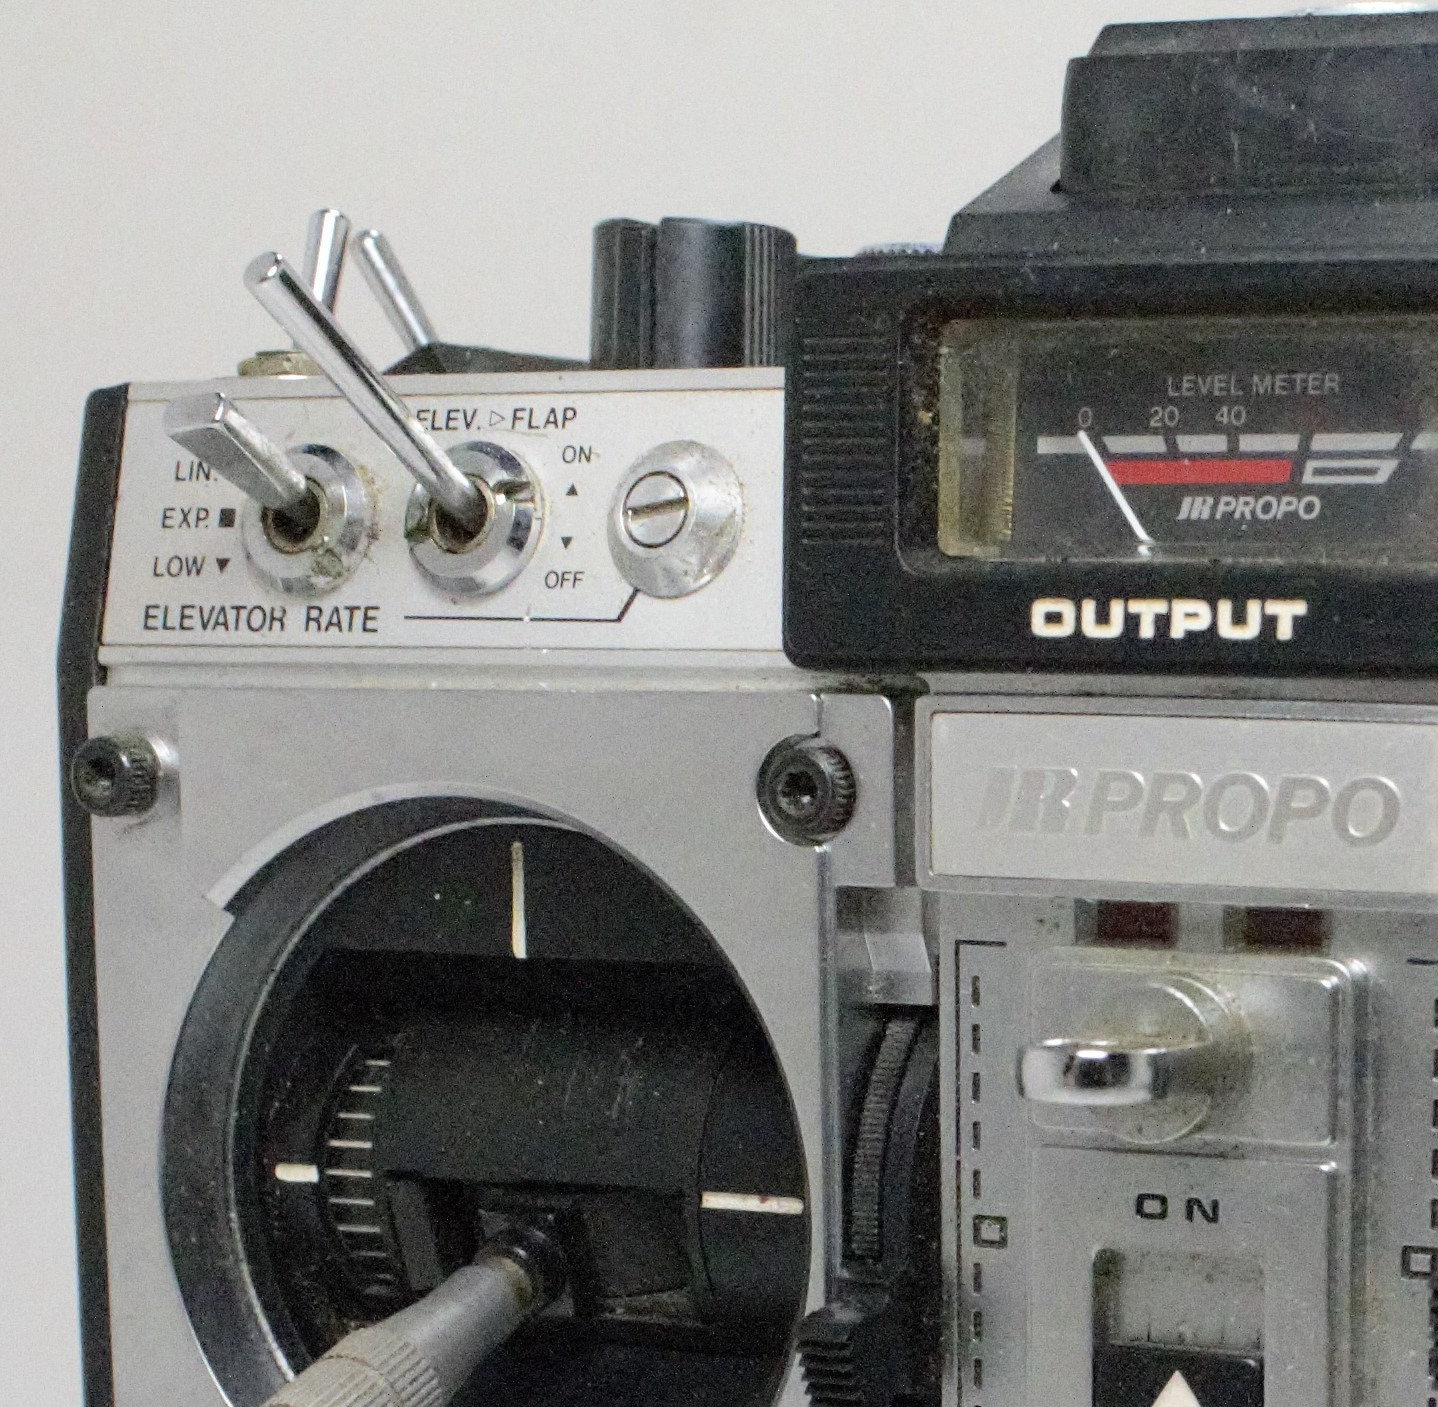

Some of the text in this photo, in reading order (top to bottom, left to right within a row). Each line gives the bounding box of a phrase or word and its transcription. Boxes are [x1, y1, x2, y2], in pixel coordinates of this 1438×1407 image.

[1167, 373, 1340, 397] LEVEL METER
[511, 407, 577, 430] FLAP
[1077, 405, 1248, 428] 0 20 40
[562, 446, 593, 463] ON
[162, 507, 210, 529] EXP.
[1215, 497, 1321, 520] PROPO
[153, 556, 206, 577] LOW
[545, 571, 585, 588] OFF
[143, 605, 380, 632] ELEVATOR RATE
[1030, 598, 1309, 641] OUTPUT
[1083, 768, 1401, 847] PROPO
[1135, 1193, 1220, 1224] ON
